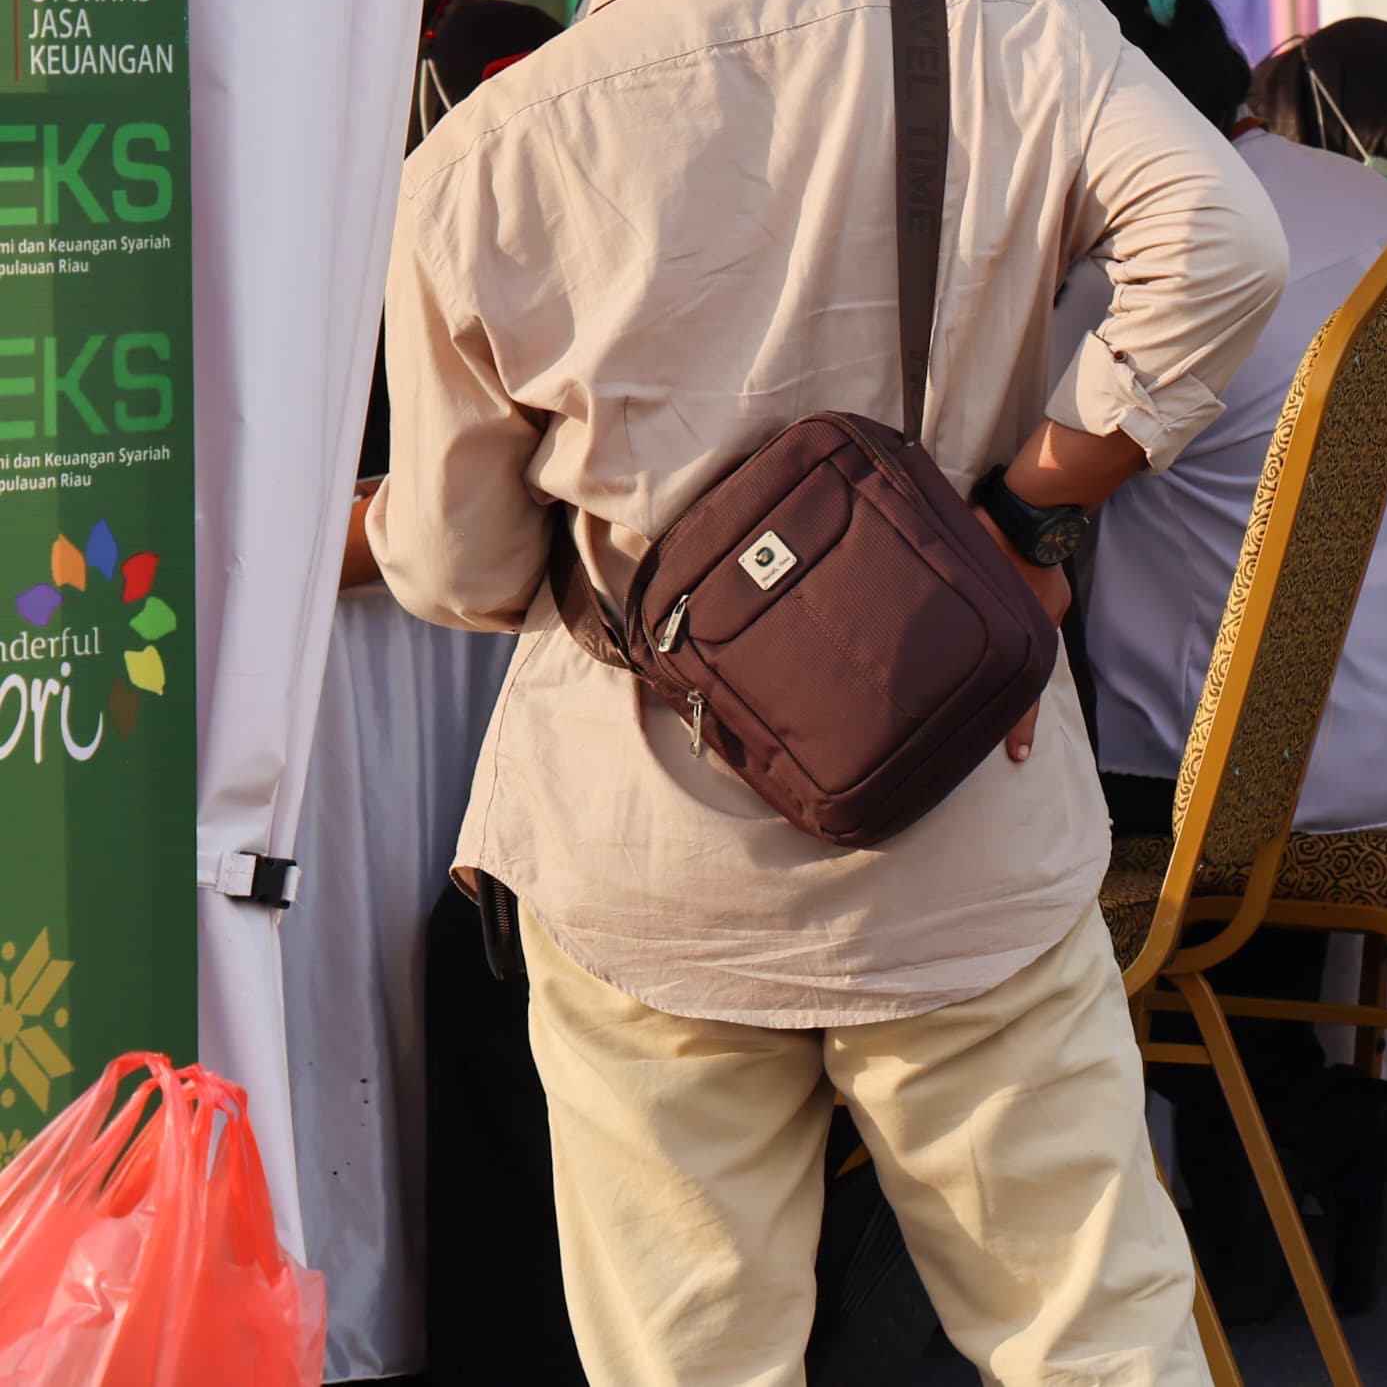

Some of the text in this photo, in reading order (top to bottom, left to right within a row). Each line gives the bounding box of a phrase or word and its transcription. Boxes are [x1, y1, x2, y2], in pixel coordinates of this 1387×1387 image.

[29, 8, 91, 39] JASA
[30, 44, 173, 75] KEUANGAN
[18, 233, 171, 255] dan Keuangan Syariah
[59, 257, 89, 273] Riau
[13, 452, 40, 469] dan
[44, 450, 115, 469] Keuangan
[119, 444, 170, 467] Syariah
[60, 472, 92, 487] Riau
